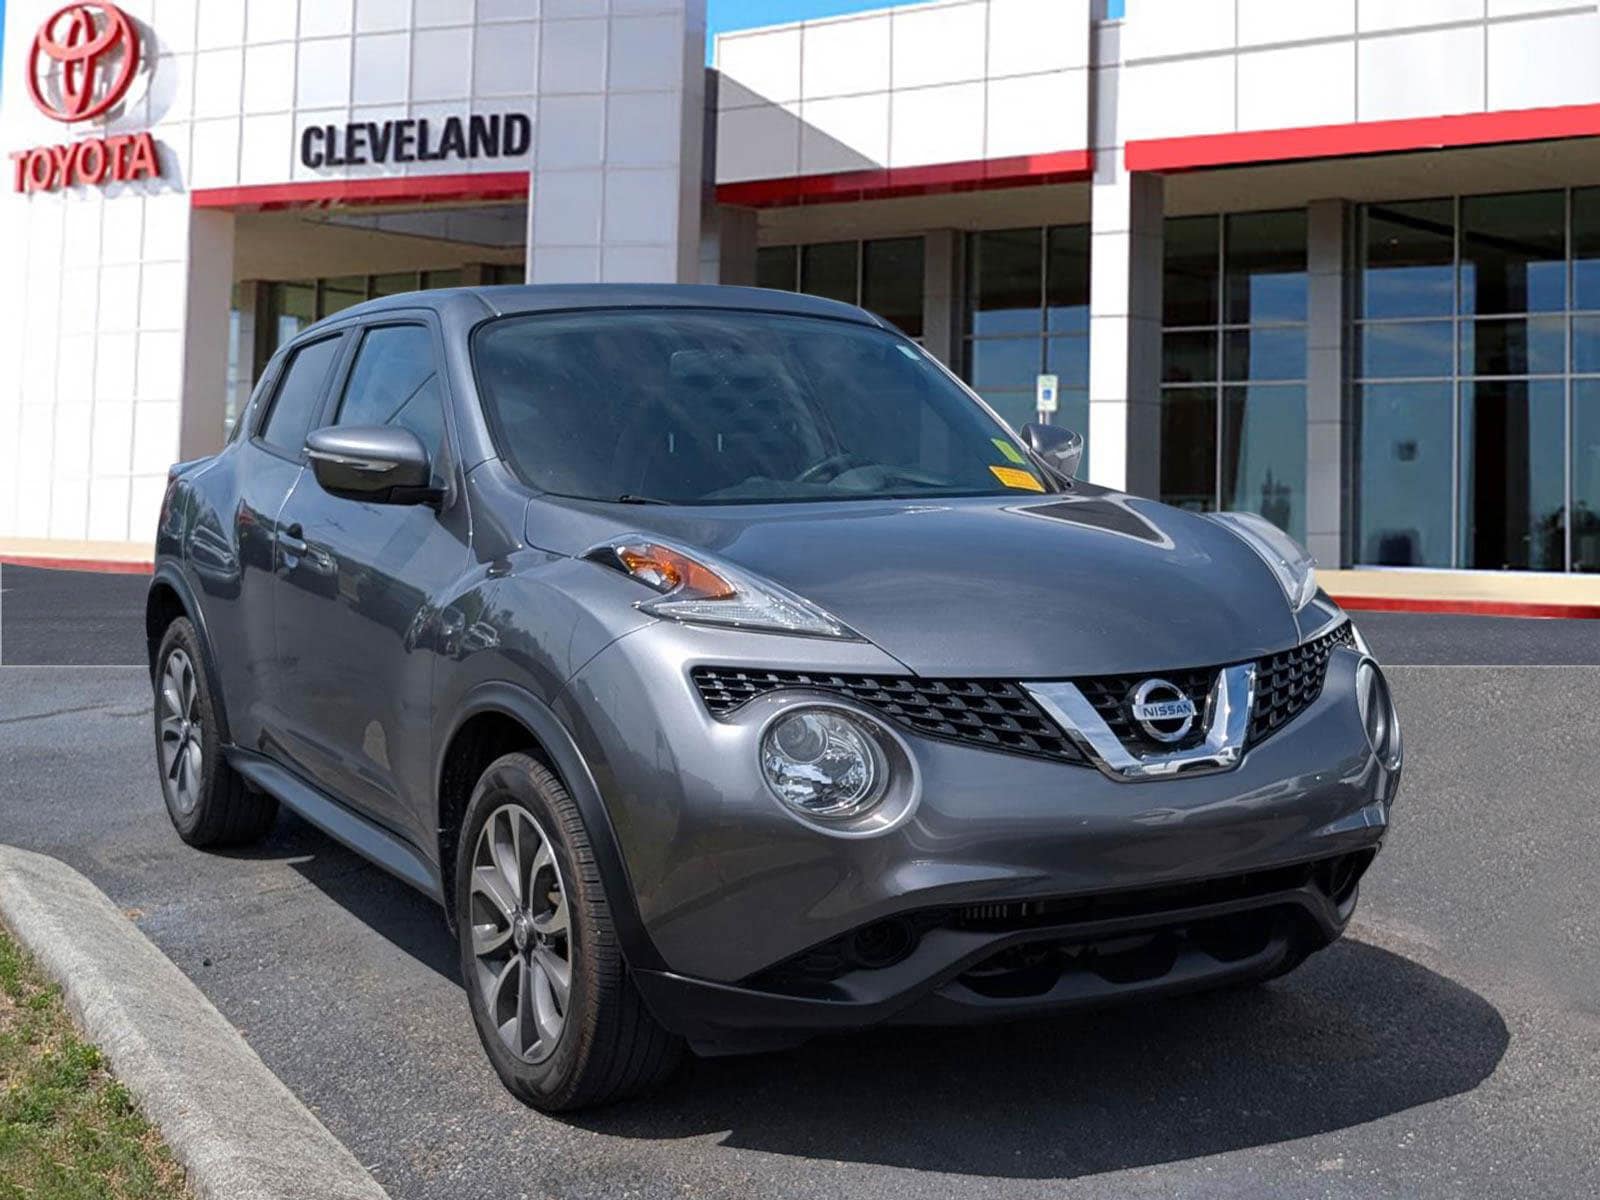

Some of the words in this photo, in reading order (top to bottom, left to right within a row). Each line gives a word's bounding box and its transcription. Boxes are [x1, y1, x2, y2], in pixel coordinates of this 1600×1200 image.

[9, 132, 162, 193] TOYOTA
[301, 113, 531, 169] CLEVELAND
[1143, 702, 1192, 717] NISSAN
